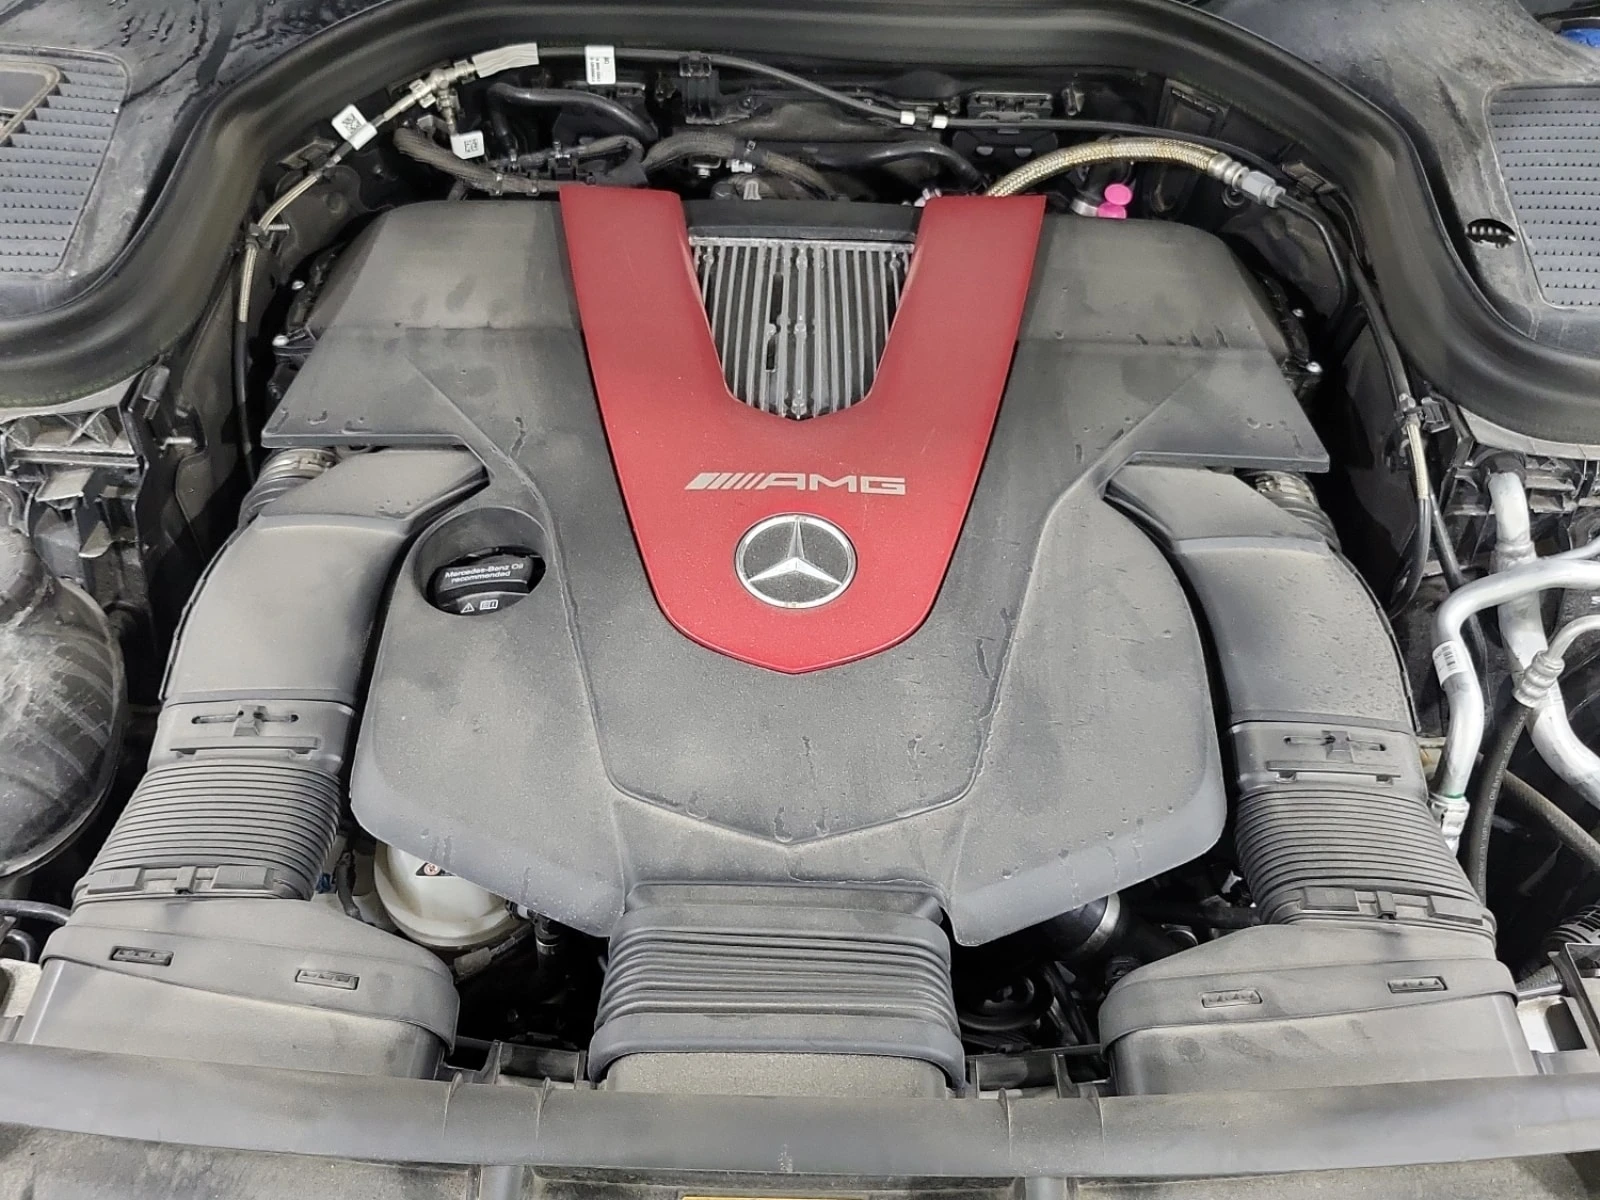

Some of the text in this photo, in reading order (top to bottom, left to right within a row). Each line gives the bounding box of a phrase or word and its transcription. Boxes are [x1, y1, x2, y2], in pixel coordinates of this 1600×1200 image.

[755, 473, 906, 495] AMG
[445, 565, 509, 578] Mercedes-Benz
[451, 571, 511, 584] recommended
